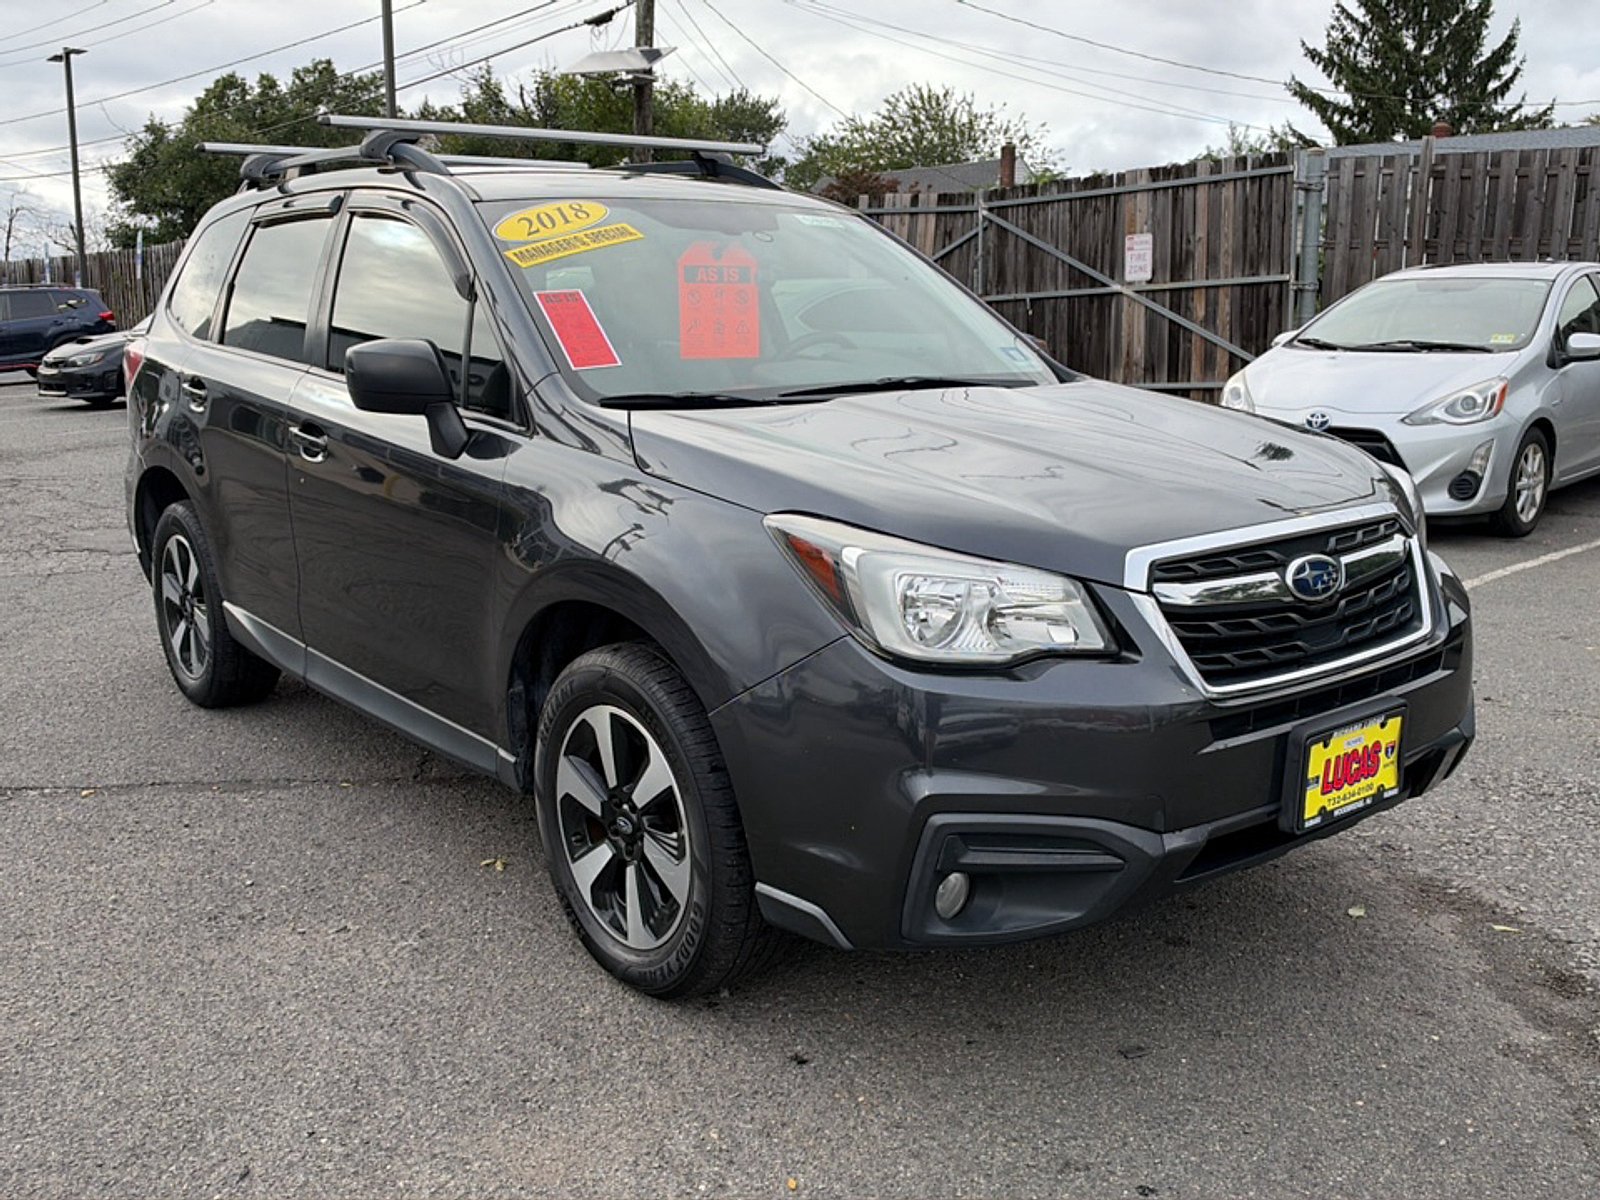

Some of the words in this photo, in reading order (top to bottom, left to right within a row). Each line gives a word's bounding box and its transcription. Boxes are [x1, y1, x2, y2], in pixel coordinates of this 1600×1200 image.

[517, 202, 590, 237] 2018
[512, 235, 591, 263] MANAGER'S
[584, 226, 638, 245] SPECIAL
[696, 266, 718, 281] AS
[723, 266, 740, 281] IS
[1321, 740, 1382, 796] LUCAS
